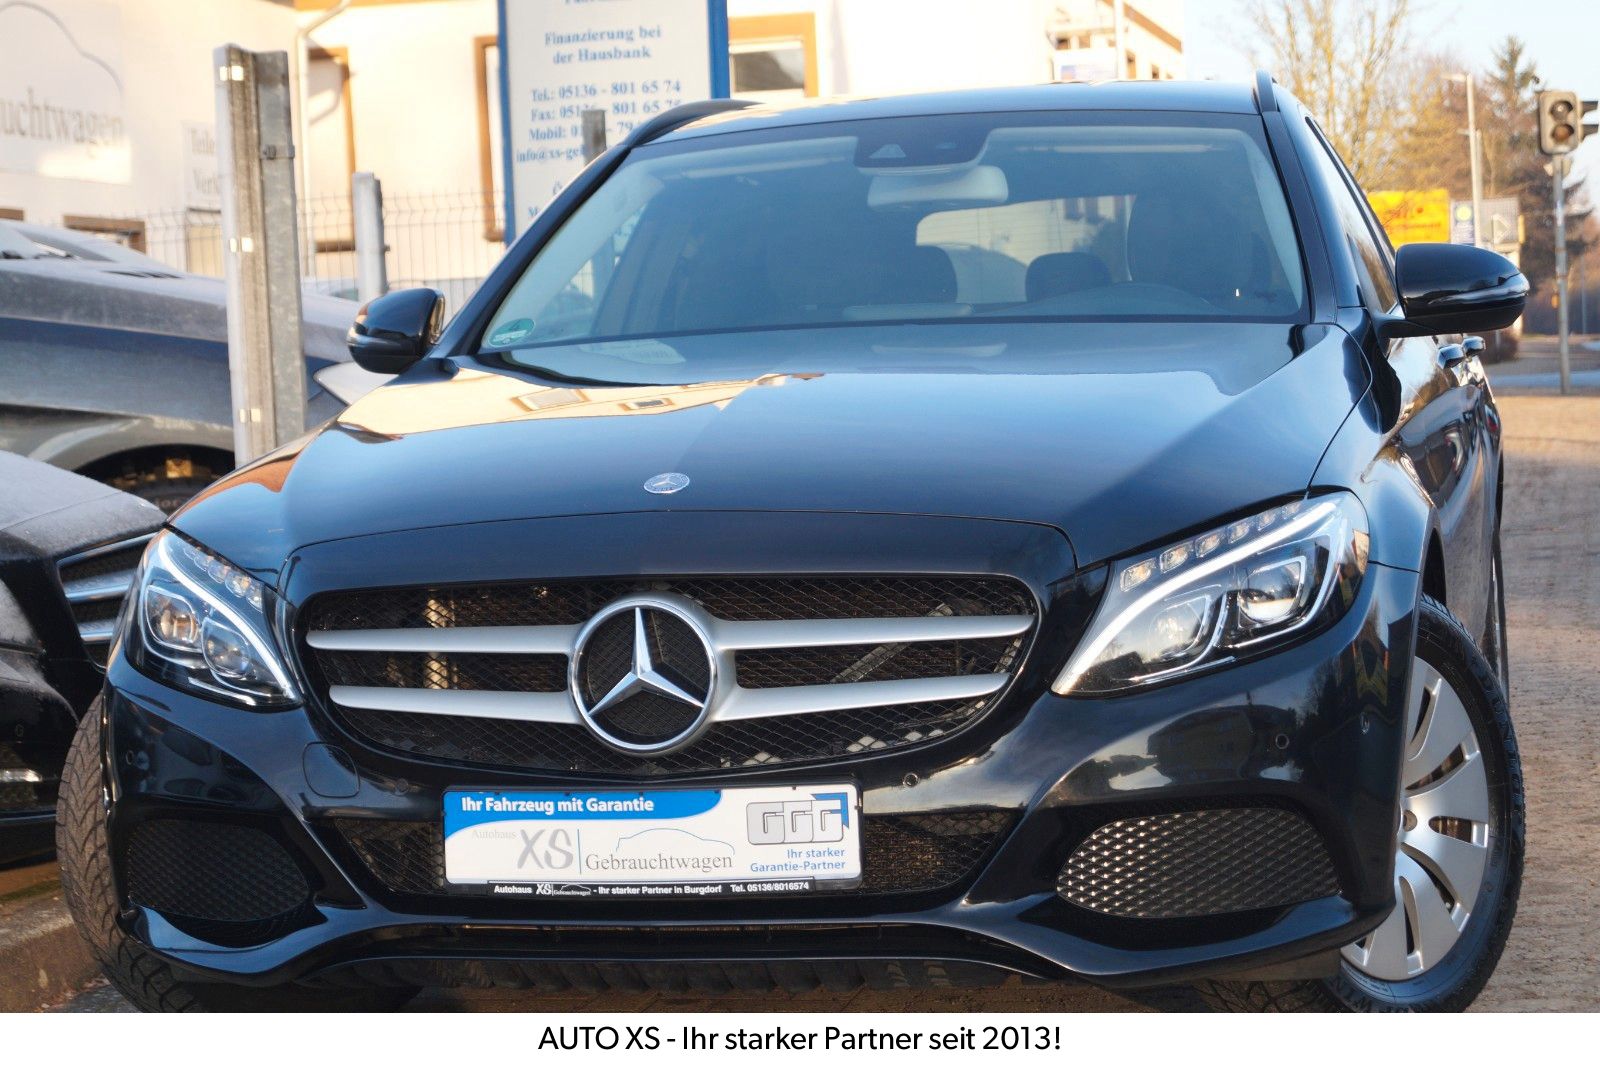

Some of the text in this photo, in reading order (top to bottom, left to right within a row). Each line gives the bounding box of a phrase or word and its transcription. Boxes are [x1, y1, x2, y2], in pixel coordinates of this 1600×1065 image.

[545, 25, 661, 47] Finanzierung bei
[553, 45, 652, 65] der Hausbank
[559, 84, 597, 100] 05136
[611, 81, 635, 96] 801
[641, 80, 659, 94] 65
[664, 78, 682, 93] 74
[530, 108, 555, 122] Fax:
[612, 101, 636, 115] 801
[643, 99, 661, 113] 65
[528, 126, 566, 142] Mobil:
[461, 796, 655, 816] Ihr Fahrzeug mit Garantie
[471, 828, 733, 876] Autohaus XS Gebrauchtwagen
[787, 847, 845, 859] Ihr starker
[750, 860, 846, 873] Garantie-Partner
[494, 885, 533, 894] Autohaus
[536, 883, 552, 895] XS
[599, 886, 609, 895] Ihr
[611, 886, 641, 895] starker
[642, 886, 672, 895] Partner
[684, 885, 722, 896] Burgdorf
[730, 884, 746, 893] Tel.
[747, 882, 809, 893] 05136/8016574
